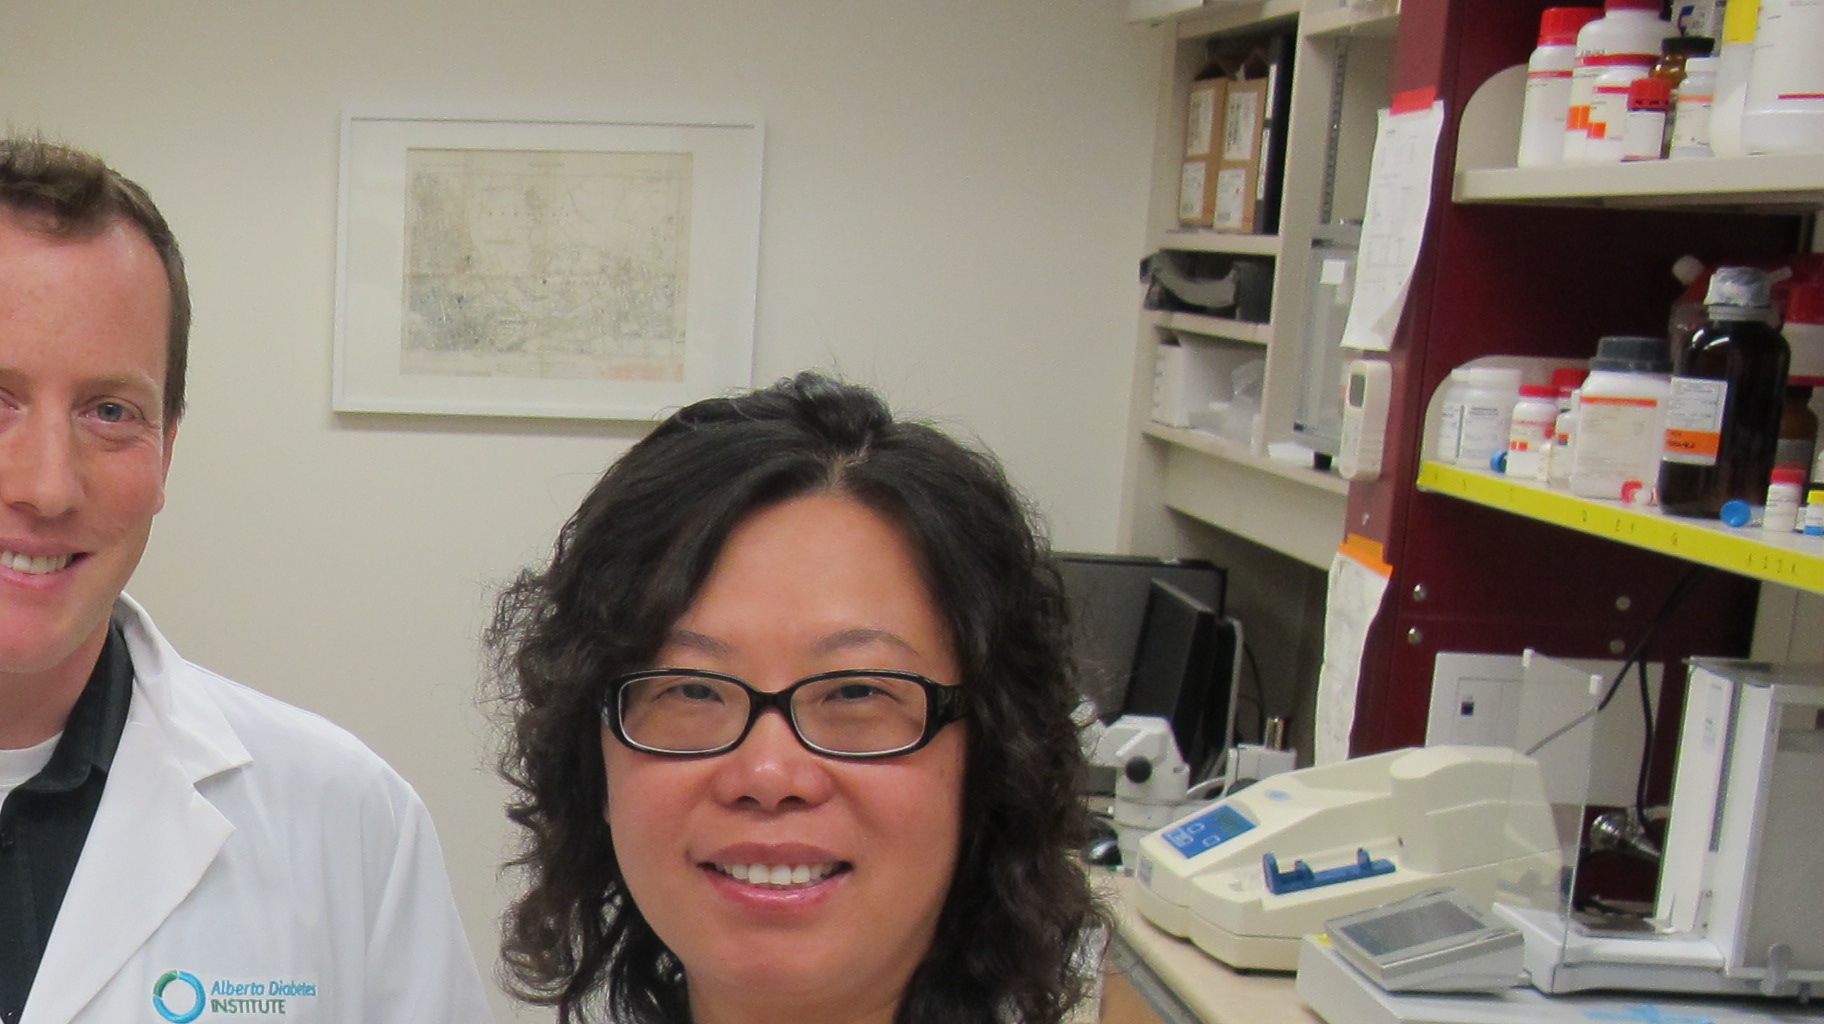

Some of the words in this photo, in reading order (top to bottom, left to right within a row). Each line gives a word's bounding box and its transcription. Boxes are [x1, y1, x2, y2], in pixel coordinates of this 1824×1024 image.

[211, 980, 265, 996] Alberta
[269, 980, 317, 997] Diabetes
[211, 999, 286, 1015] INSTITUTE
